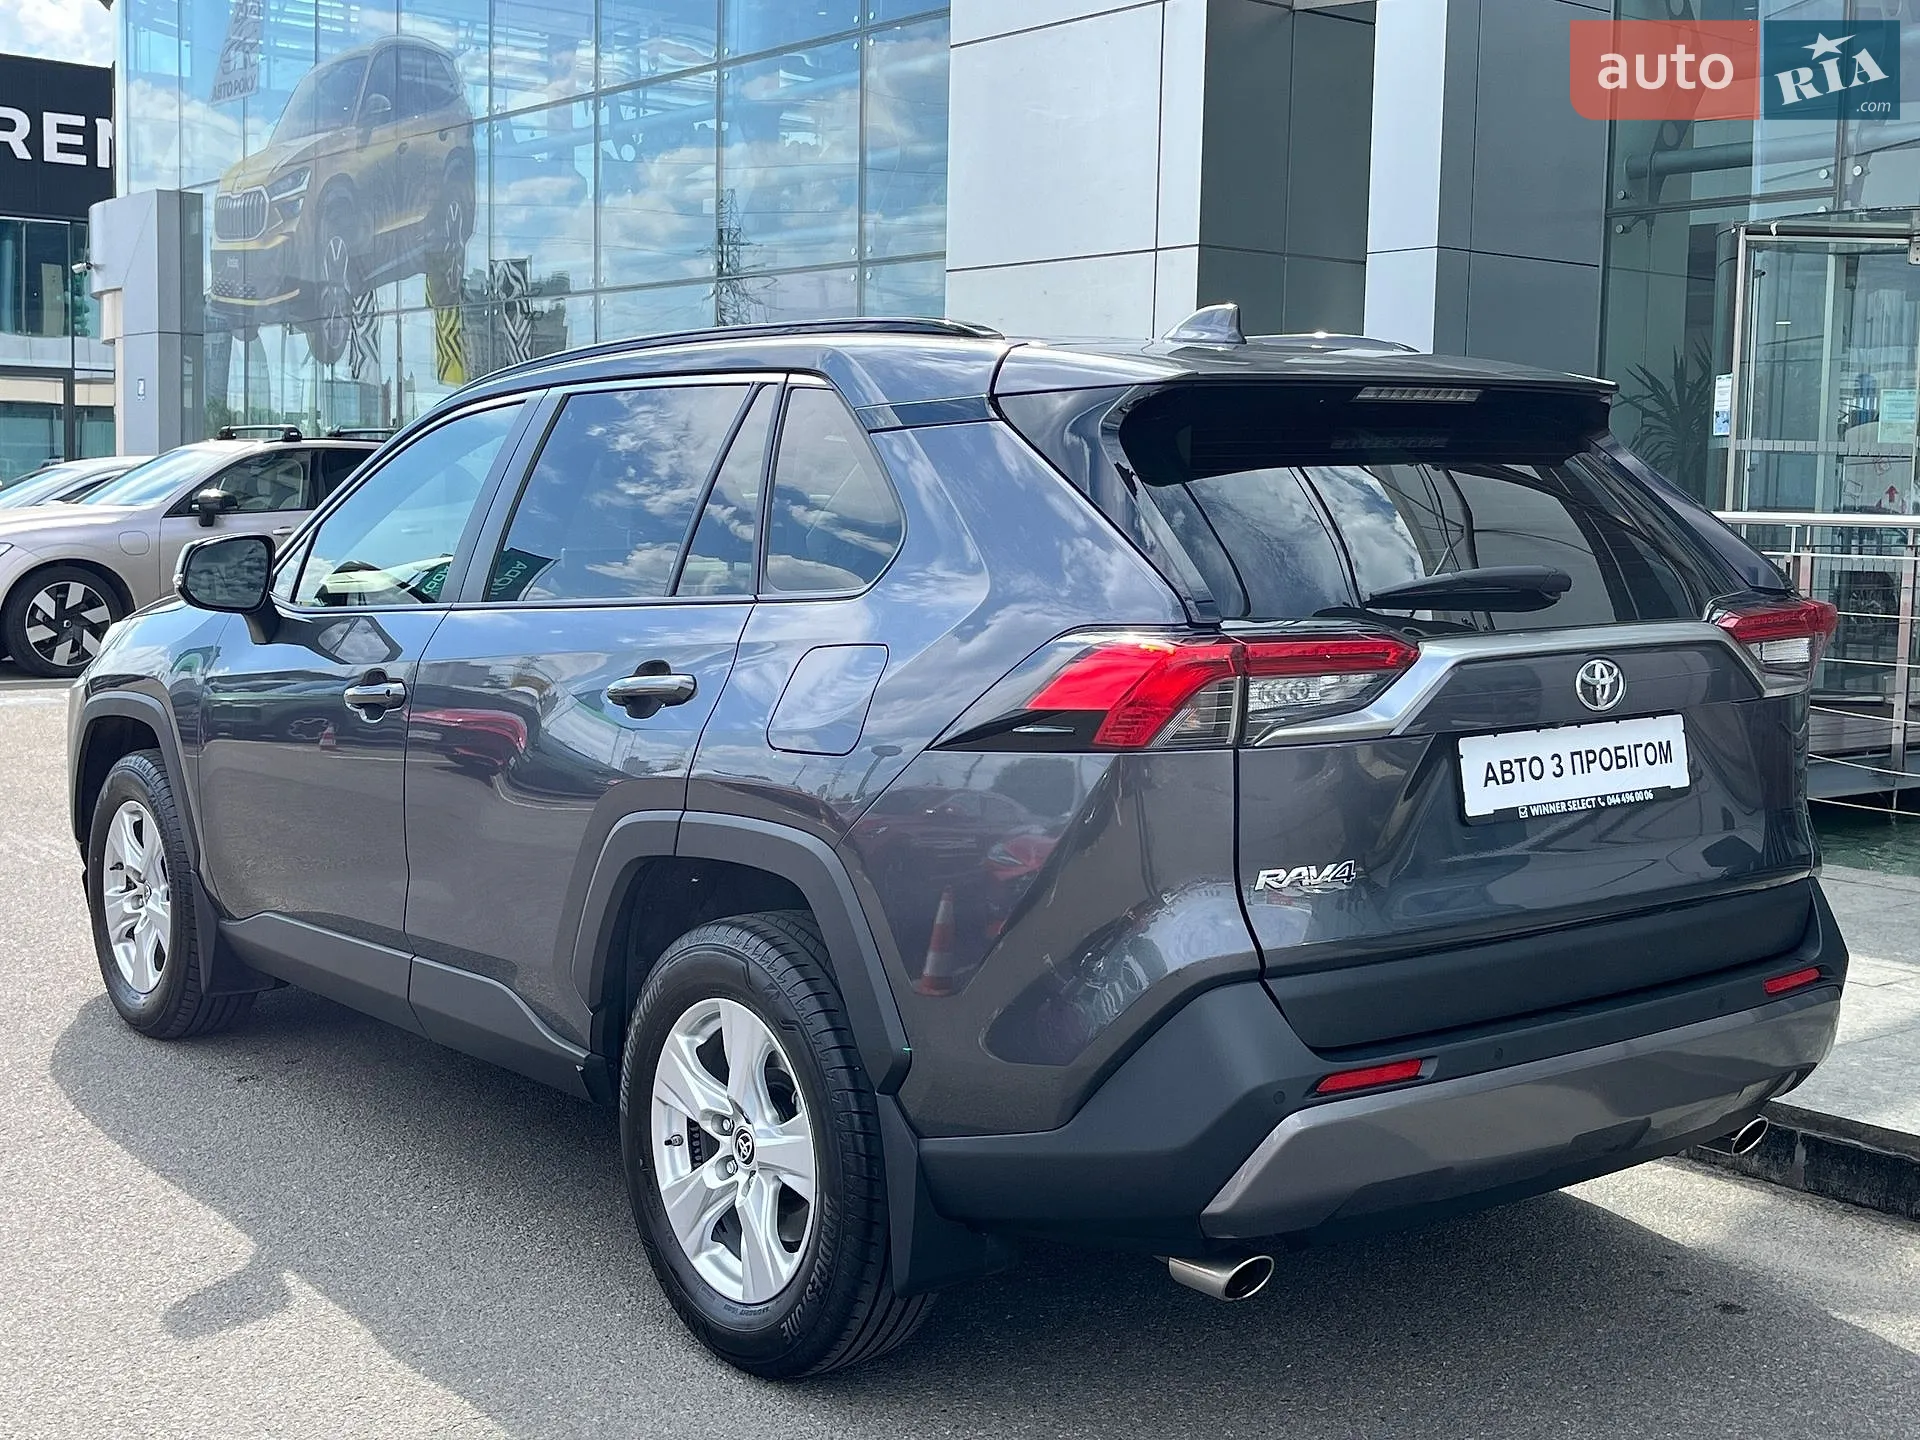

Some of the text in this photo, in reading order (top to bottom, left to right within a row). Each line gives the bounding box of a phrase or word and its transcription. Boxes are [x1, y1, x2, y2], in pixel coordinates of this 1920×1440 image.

[1483, 755, 1545, 788] АВТО
[1570, 740, 1673, 776] ПРОБІГОМ
[1529, 801, 1568, 817] WINNER
[1567, 797, 1597, 812] SELECT
[1621, 792, 1635, 805] 496
[1634, 790, 1644, 802] 00
[1644, 789, 1654, 800] 06
[1254, 859, 1357, 891] RAV4
[780, 1191, 842, 1345] BRIDGESTONE
